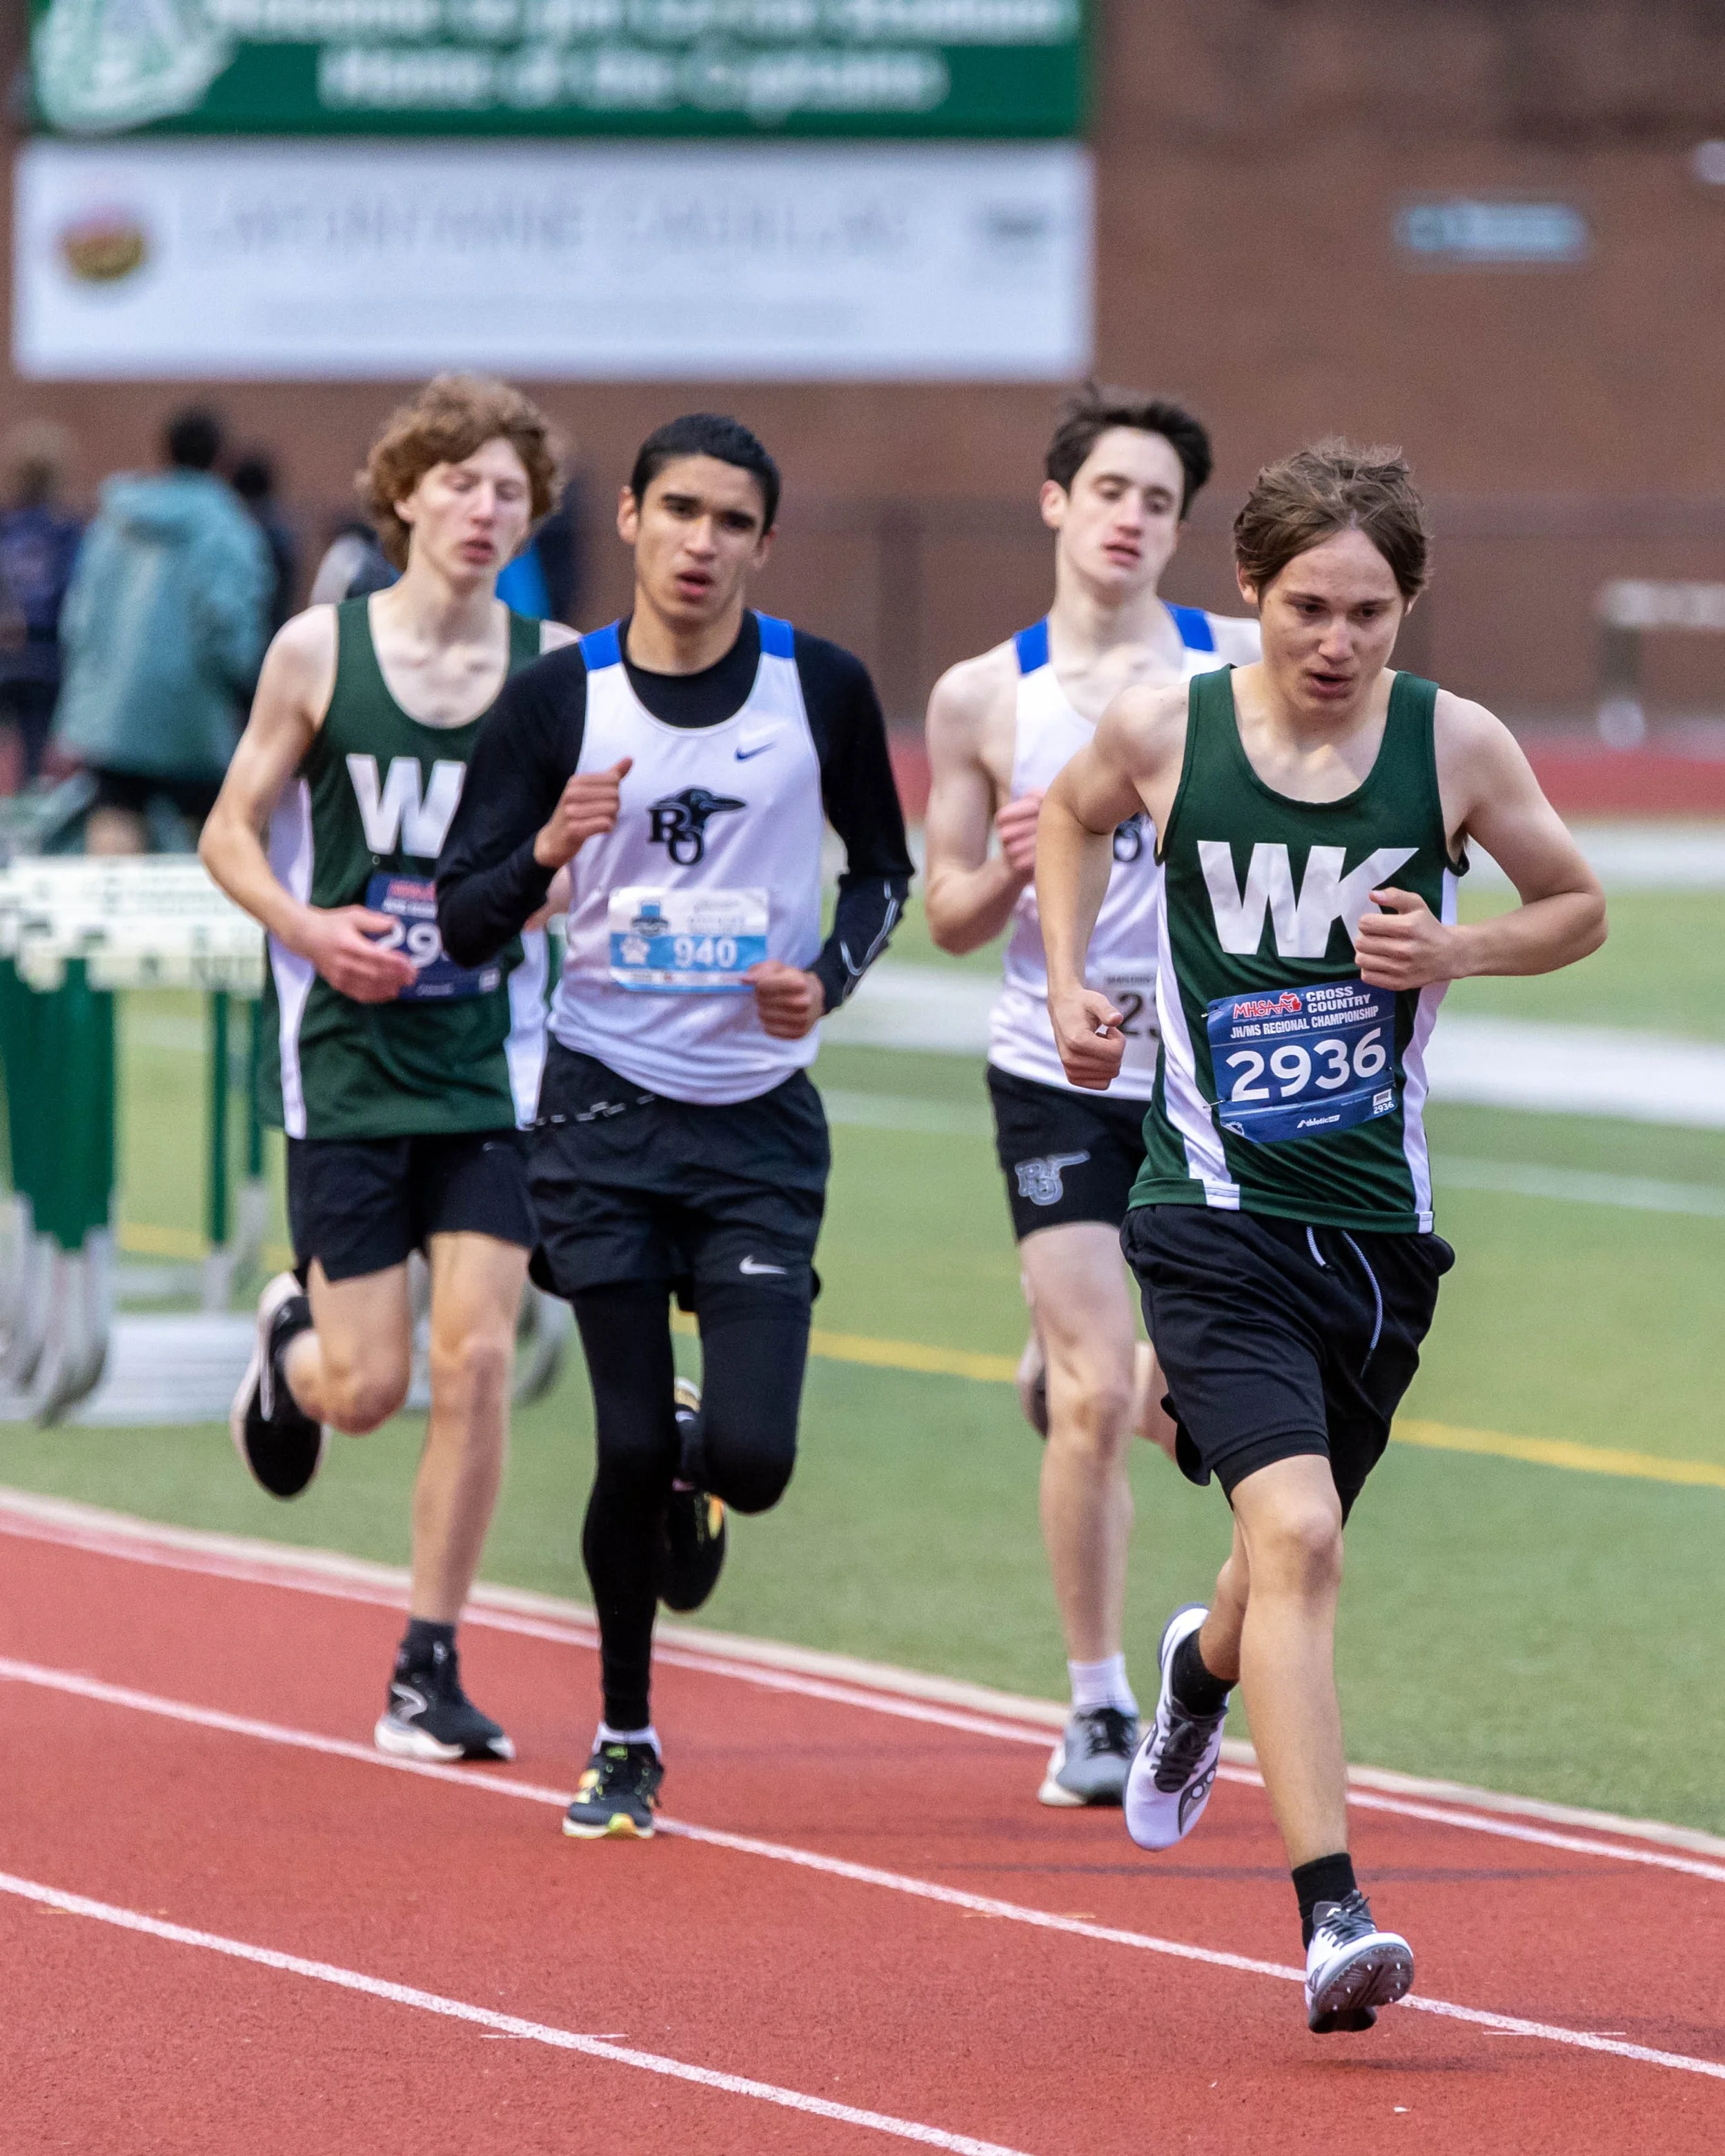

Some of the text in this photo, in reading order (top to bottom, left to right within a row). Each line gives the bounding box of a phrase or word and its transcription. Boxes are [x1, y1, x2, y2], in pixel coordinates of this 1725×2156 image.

[346, 753, 467, 859] W
[1197, 840, 1419, 958] WK
[673, 936, 738, 968] 940
[1232, 996, 1297, 1020] MHSAA
[1305, 986, 1354, 1002] CROSS
[1307, 993, 1371, 1013] COUNTRY
[1230, 1023, 1261, 1039] JH/MS
[1263, 1018, 1310, 1035] REGIONAL
[1311, 1005, 1379, 1028] CHAMPIONSHIP
[1225, 1027, 1386, 1102] 2936
[1373, 1101, 1395, 1115] 2936
